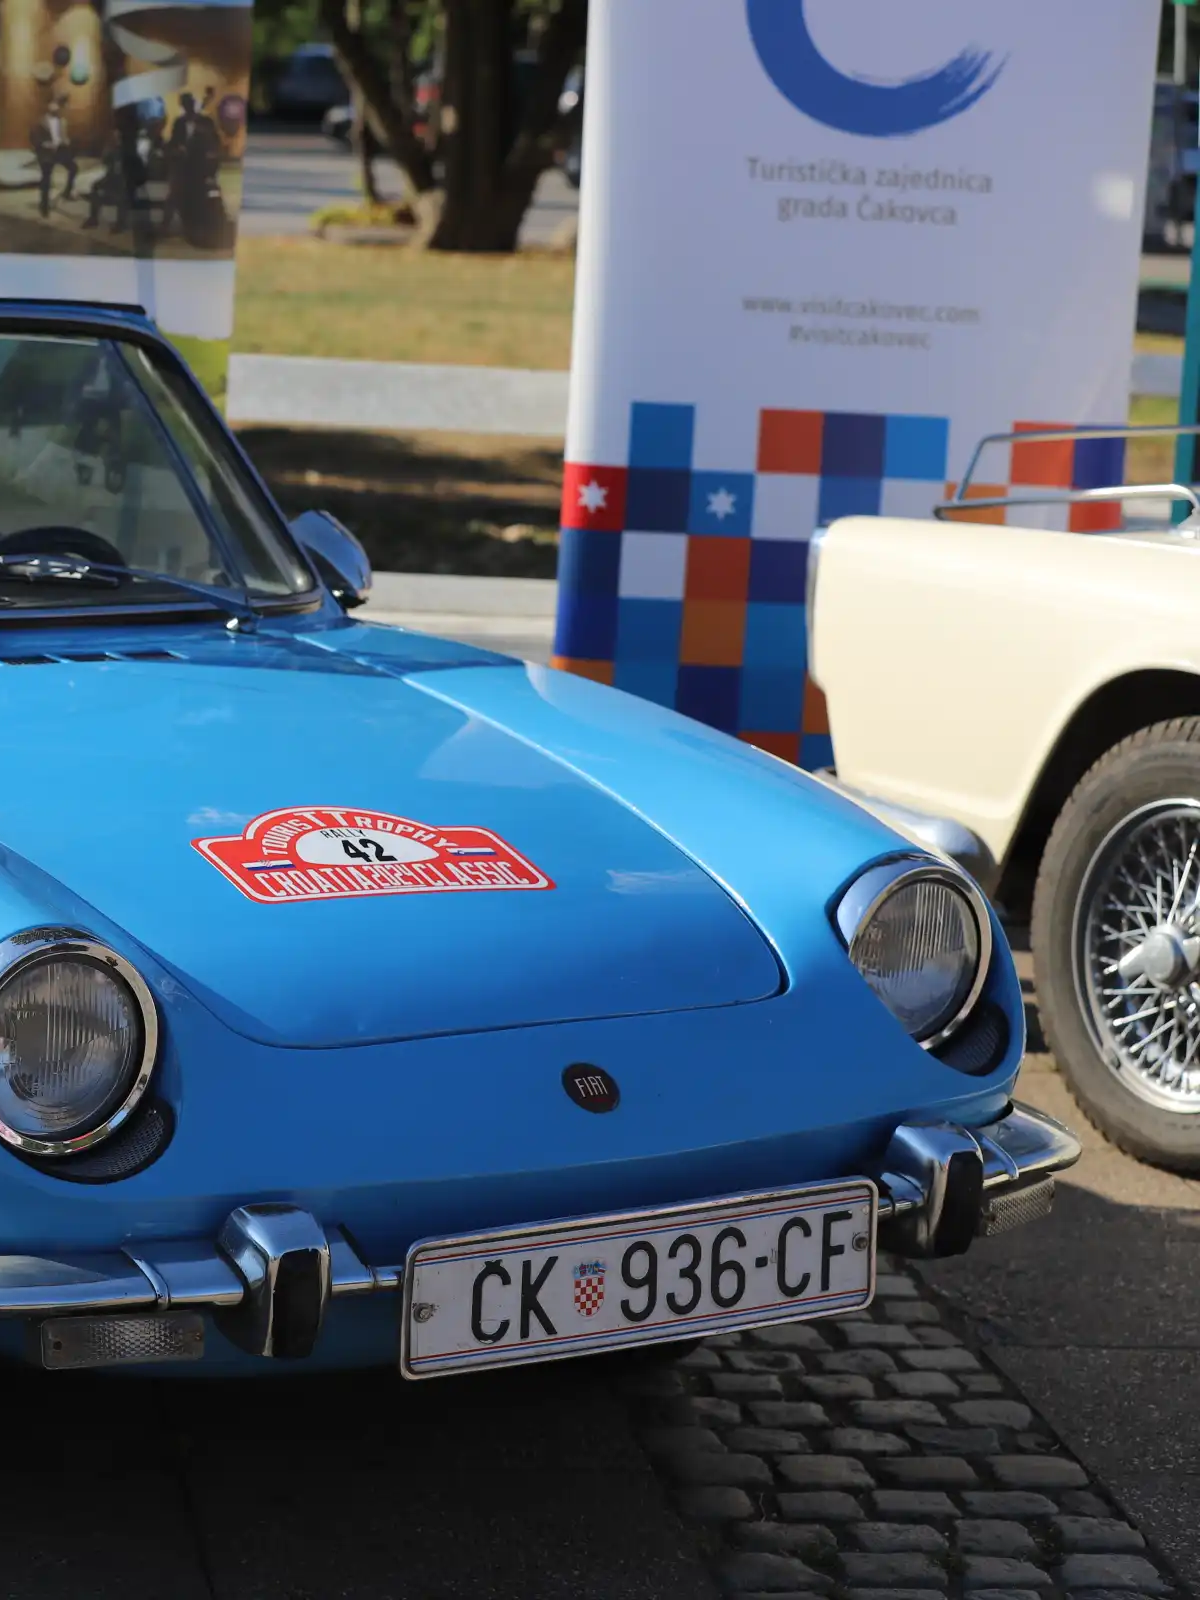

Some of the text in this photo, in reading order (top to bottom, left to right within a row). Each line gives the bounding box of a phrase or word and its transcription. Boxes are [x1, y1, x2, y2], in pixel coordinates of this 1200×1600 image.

[746, 156, 993, 193] Turistička zajednica
[778, 194, 958, 226] grada Čakovca
[742, 296, 981, 324] www.visitcakovec.com
[789, 324, 932, 350] #visitcakovec
[261, 810, 460, 856] TOURIST TROPHY
[319, 828, 370, 840] RALLY
[341, 838, 399, 863] 42
[253, 865, 381, 898] CROATIA
[410, 860, 531, 888] CLASSIC
[574, 1075, 608, 1098] FIAT
[470, 1210, 854, 1345] ČK 936-CF
